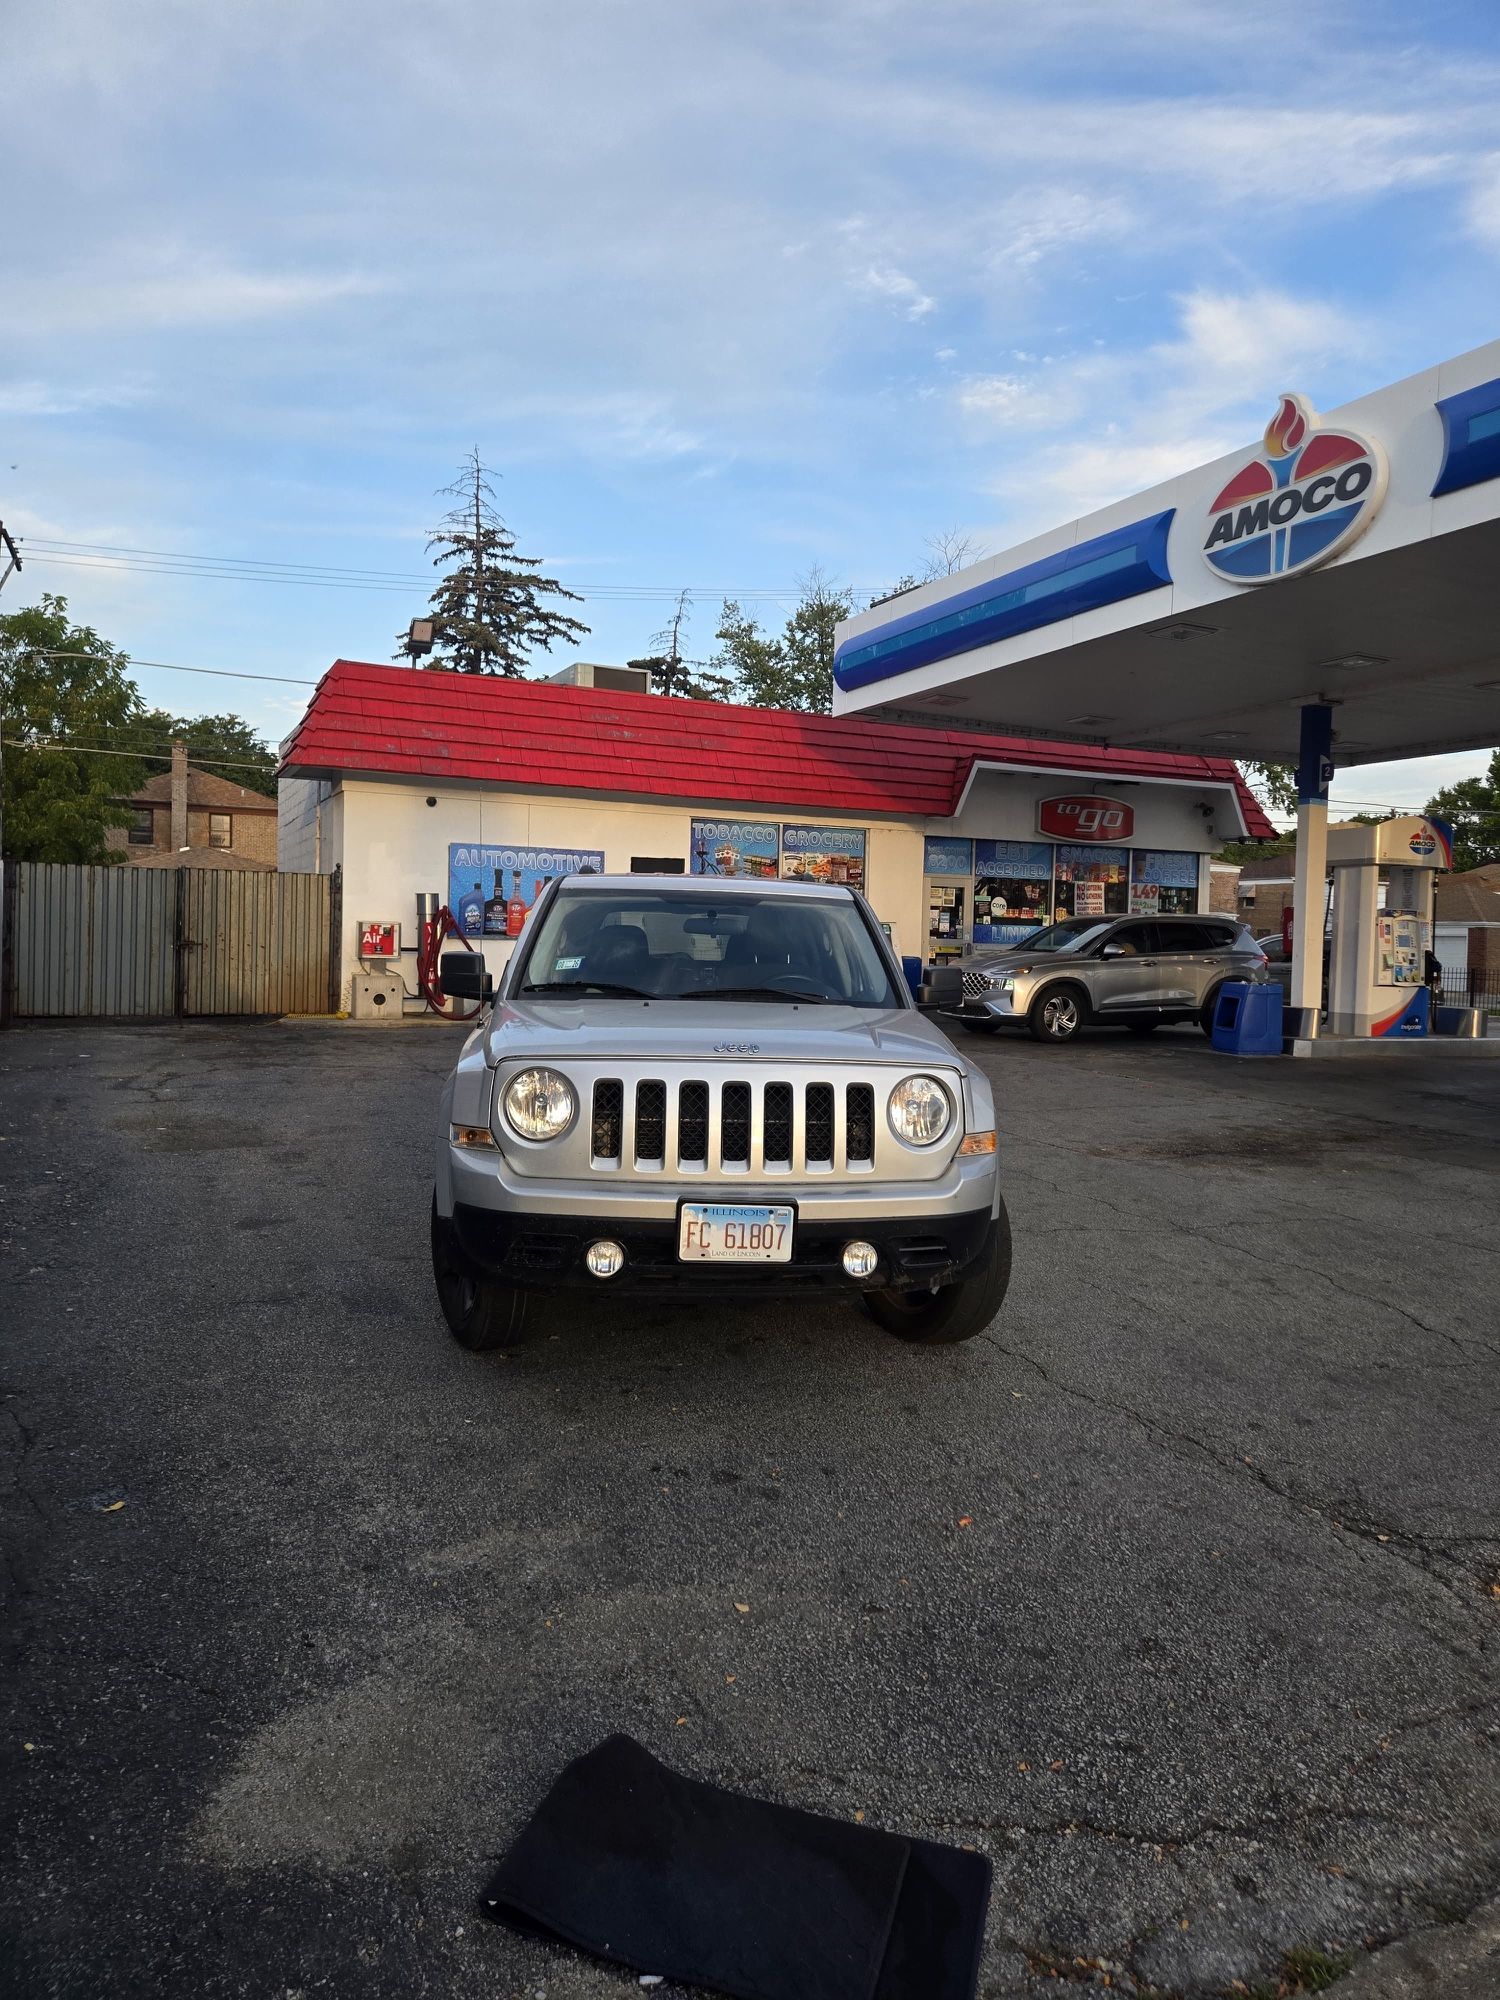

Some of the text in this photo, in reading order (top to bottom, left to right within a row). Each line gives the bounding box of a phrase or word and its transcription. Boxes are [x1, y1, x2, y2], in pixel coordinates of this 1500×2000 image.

[1203, 462, 1372, 550] AMOCO
[1324, 766, 1331, 777] 2
[1057, 803, 1124, 833] to go
[692, 822, 777, 844] TOBACCO
[784, 829, 863, 850] GROCERY
[995, 841, 1033, 861] EBT
[1409, 840, 1436, 848] AMOCO
[454, 848, 601, 874] AUTOMOTIVE
[1060, 845, 1122, 865] SNACKS
[1145, 853, 1193, 869] FRESH
[975, 861, 1047, 878] ACCEPTED
[1143, 868, 1197, 885] COFFEE
[1076, 883, 1086, 892] NO
[1076, 892, 1086, 901] NO
[992, 902, 1007, 910] core
[362, 932, 382, 943] Air
[991, 925, 1032, 941] LINK
[713, 1040, 760, 1056] Jeep
[711, 1208, 766, 1217] ILLINOIS
[687, 1221, 786, 1250] FC 61807
[737, 1250, 761, 1258] LINCOLN
